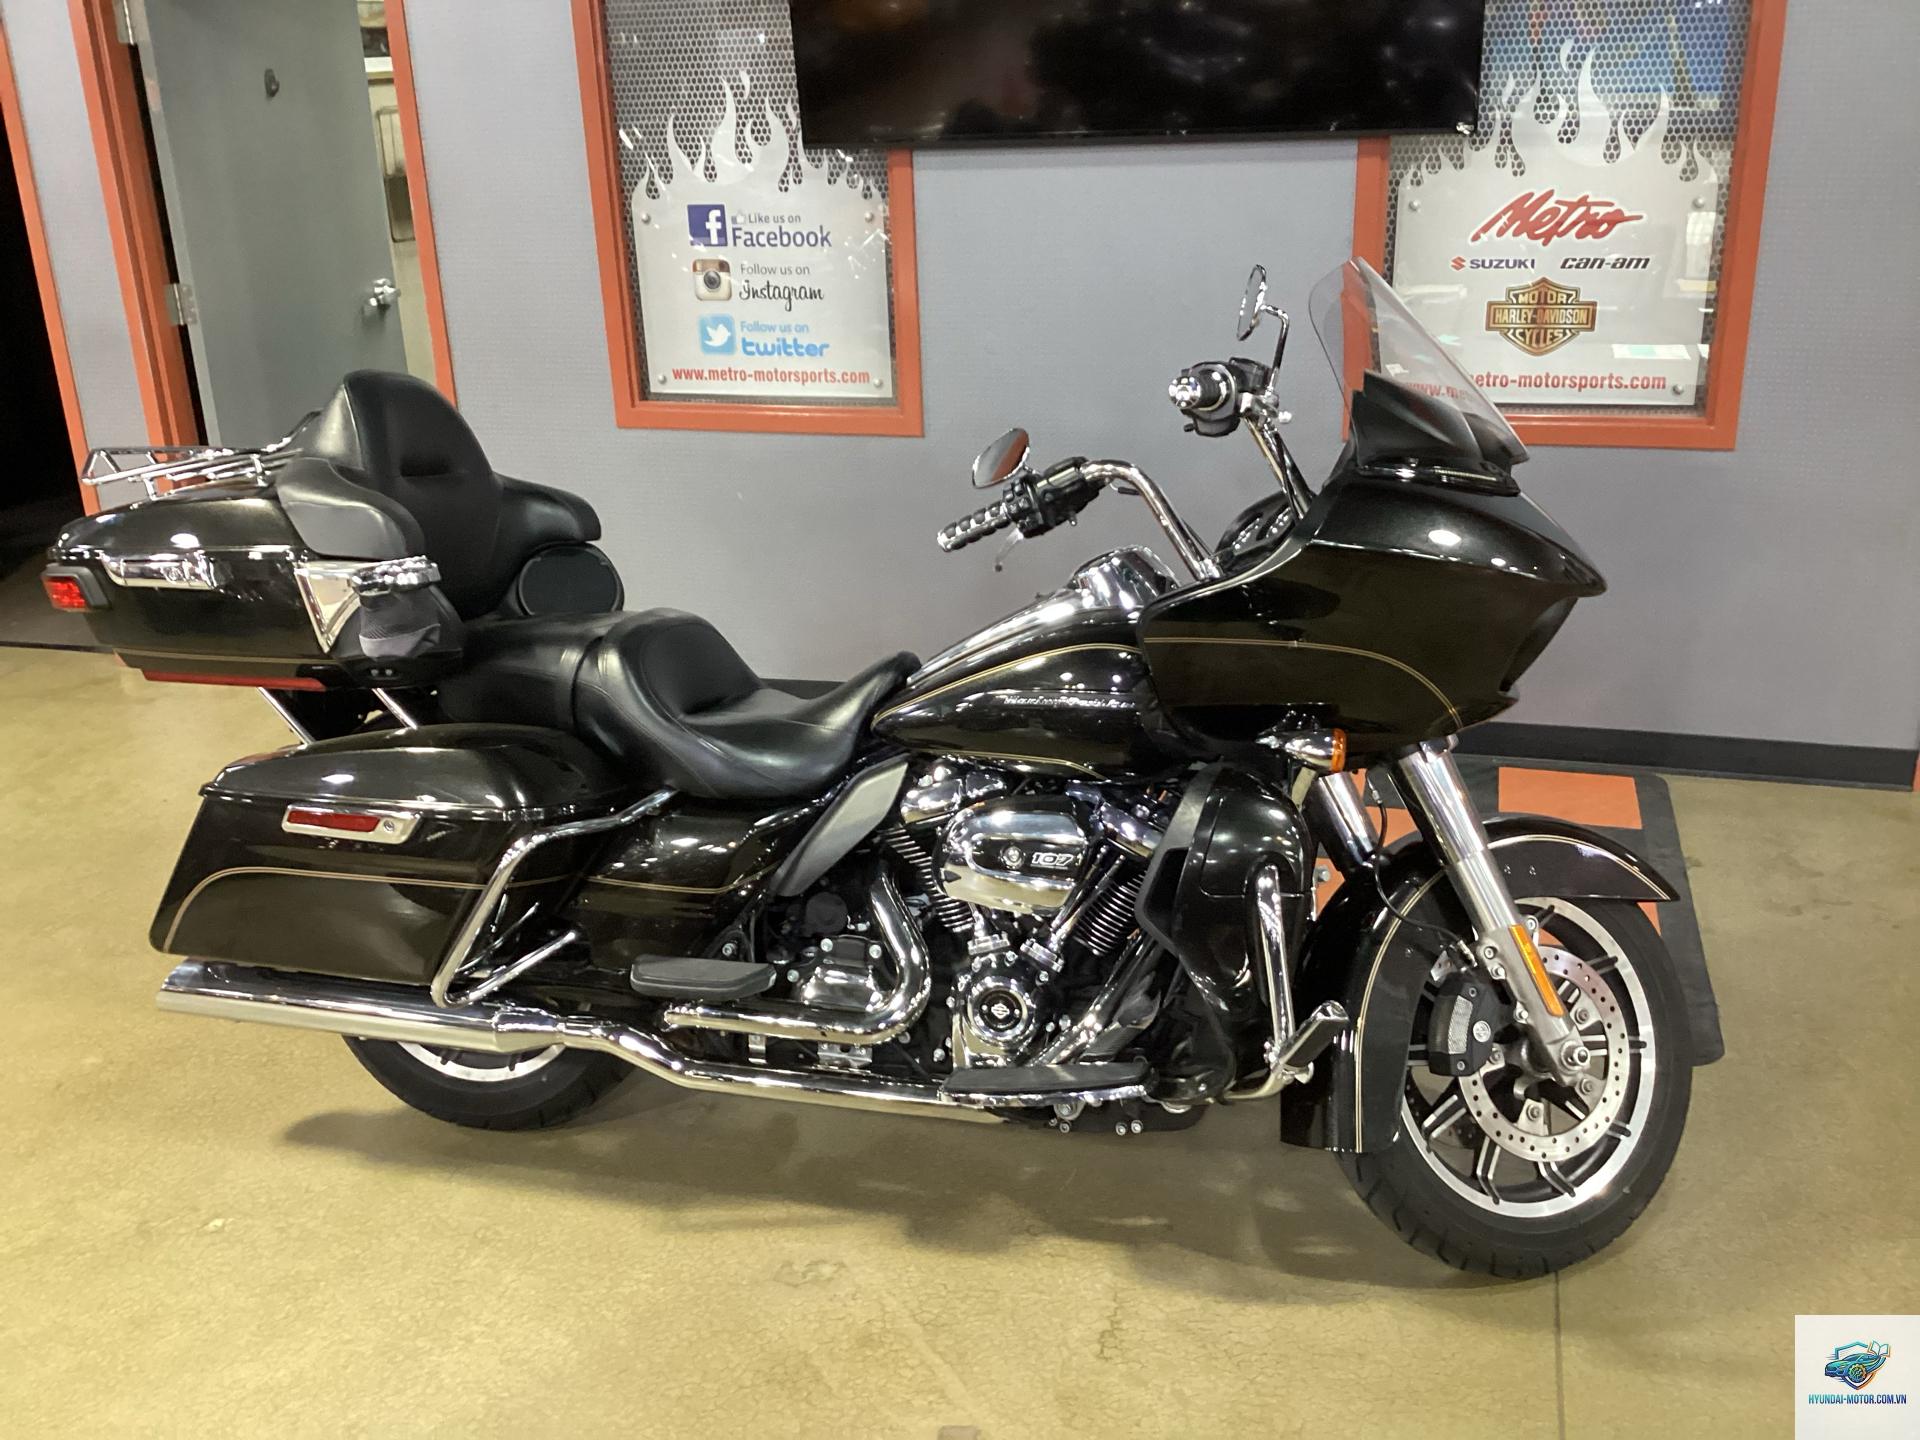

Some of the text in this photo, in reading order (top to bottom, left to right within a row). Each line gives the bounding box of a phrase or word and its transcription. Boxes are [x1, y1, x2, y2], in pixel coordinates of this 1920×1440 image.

[748, 214, 802, 224] Like us on
[1471, 189, 1643, 247] Metro
[732, 225, 832, 248] Facebook
[740, 264, 811, 276] Follow us on
[1469, 258, 1535, 270] SUZUKI
[1560, 257, 1650, 270] can-am
[739, 279, 824, 312] Instagram
[1518, 287, 1568, 304] MOTOR
[1495, 308, 1588, 324] HARLEY-DAVIDSON
[740, 321, 810, 333] Follow us on
[1515, 328, 1565, 348] CYCLES
[741, 337, 830, 357] twitter
[672, 367, 871, 386] www.metro-motorsports.com
[1031, 851, 1074, 866] 107
